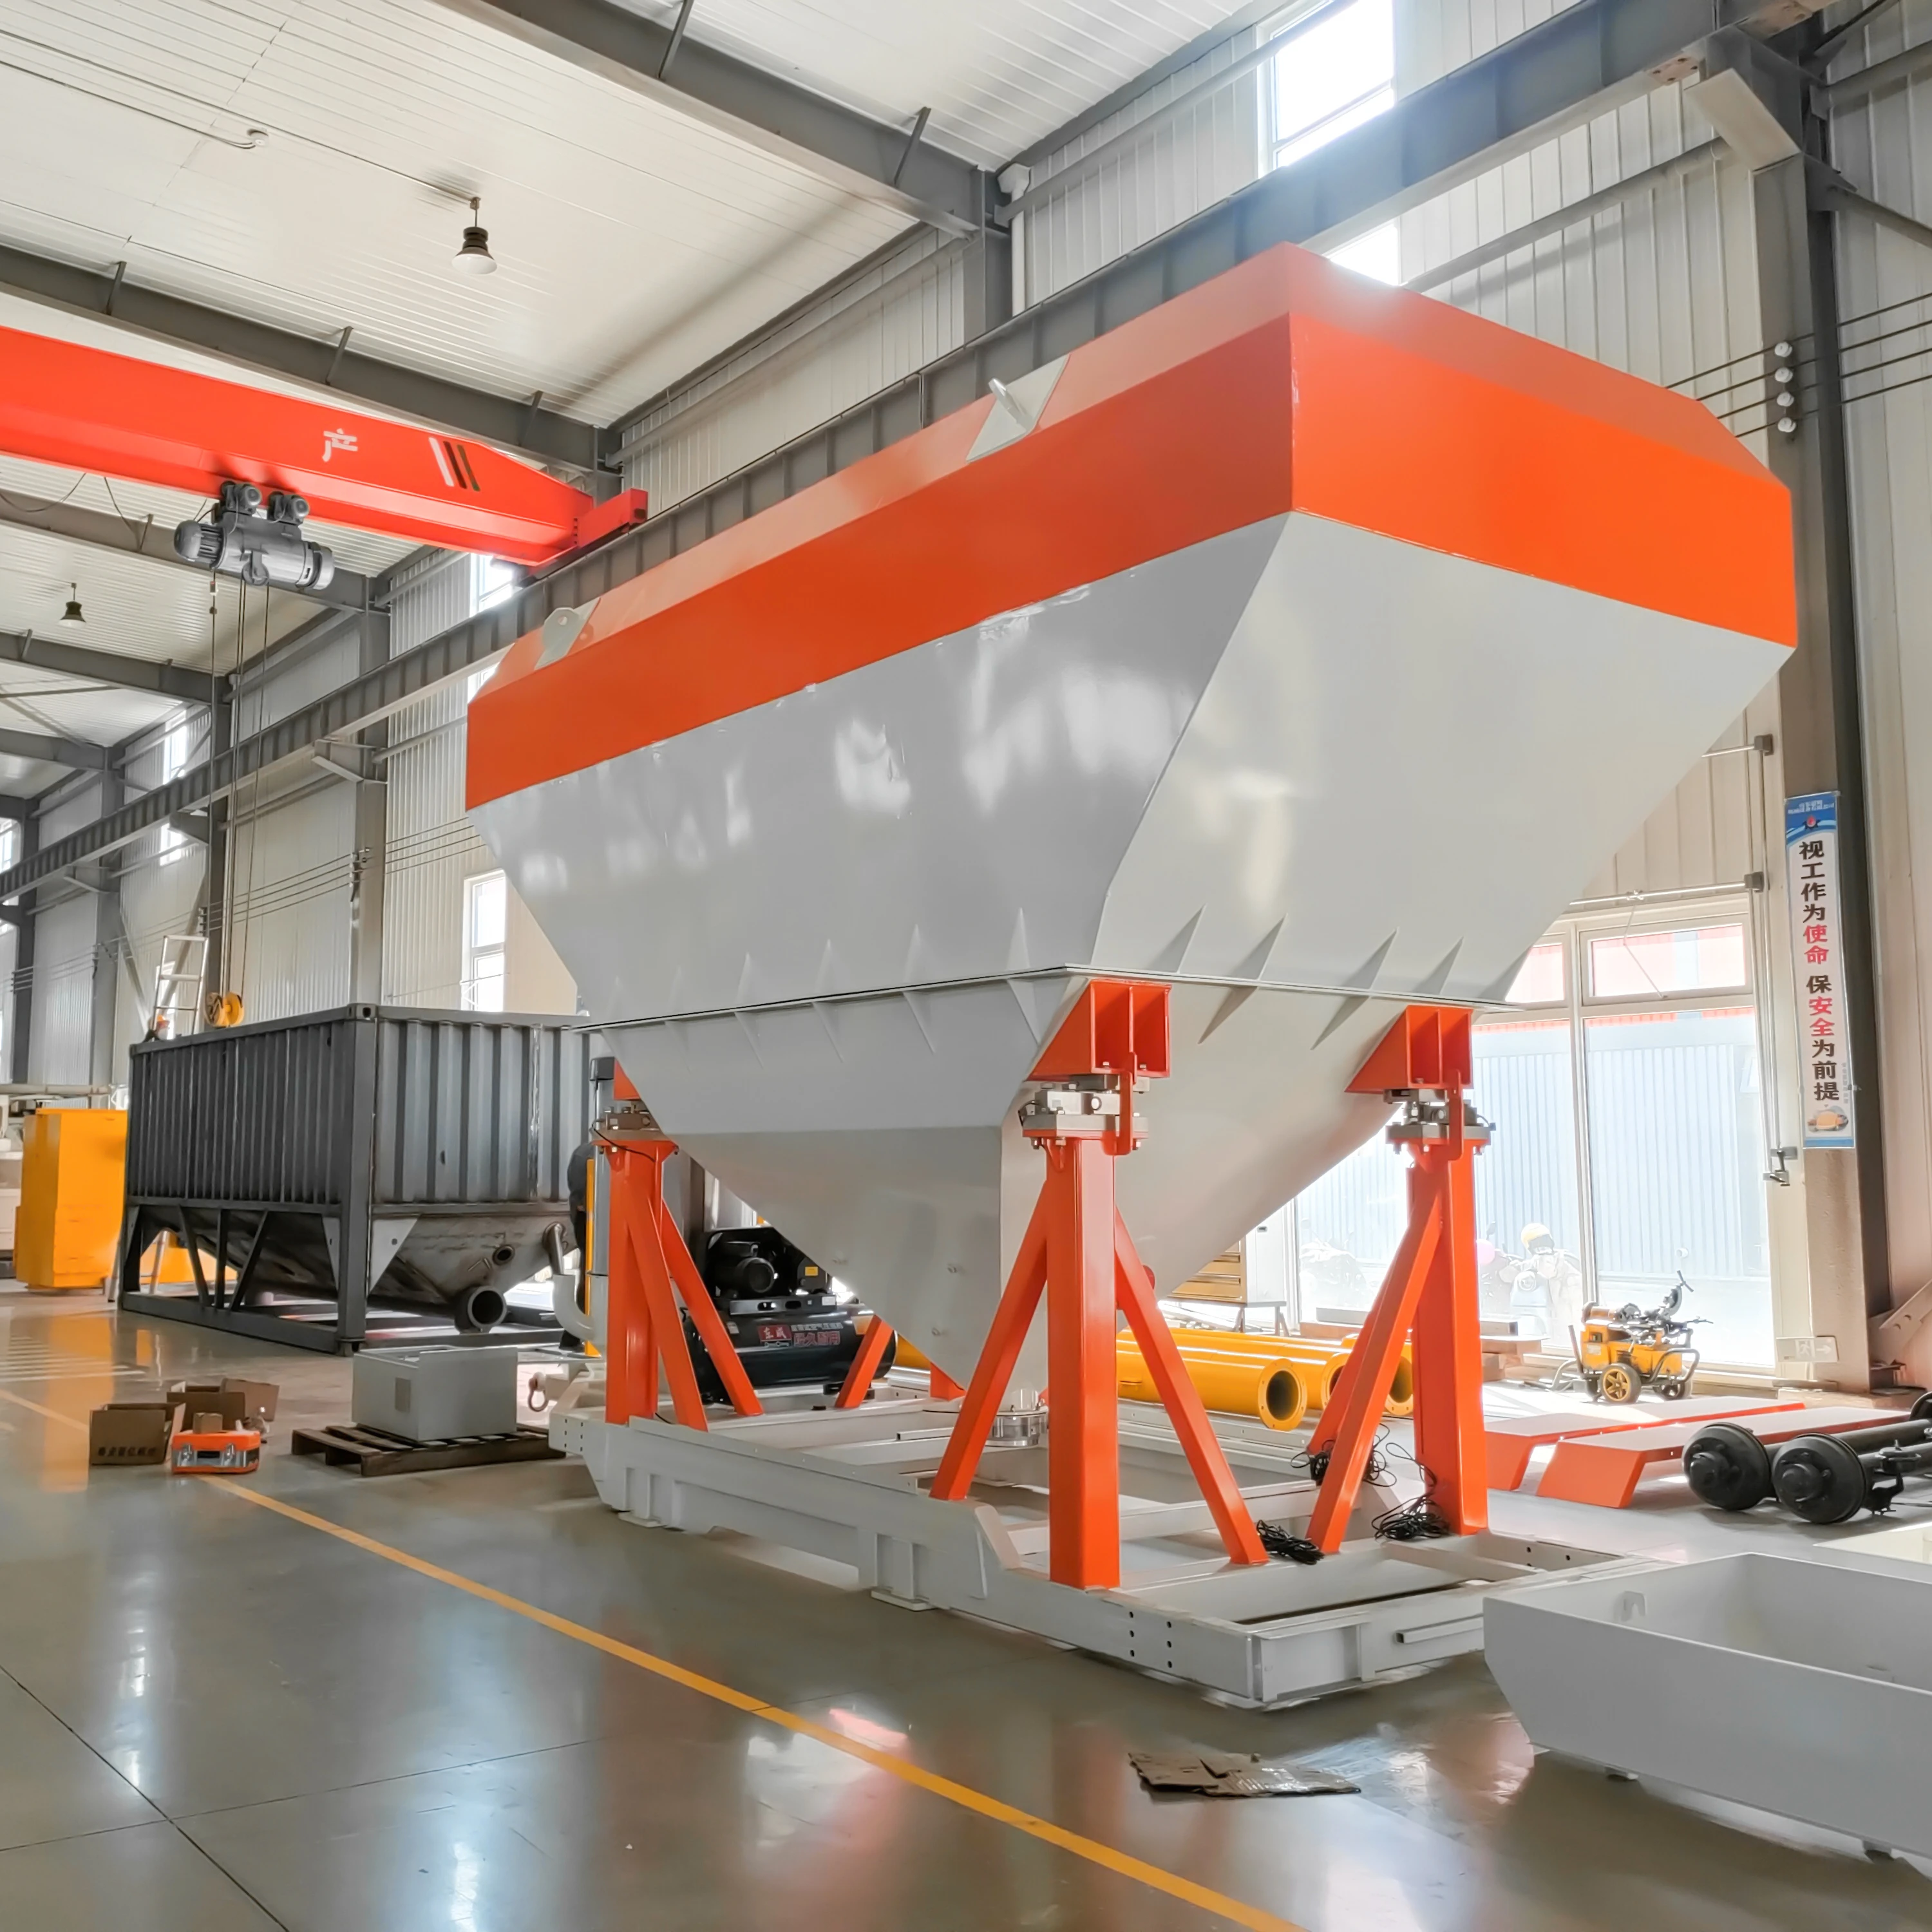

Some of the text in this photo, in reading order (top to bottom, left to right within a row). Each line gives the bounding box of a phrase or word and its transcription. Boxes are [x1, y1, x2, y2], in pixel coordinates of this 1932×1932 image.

[322, 428, 358, 462] 产
[1799, 840, 1830, 965] 视工作为使命
[1806, 974, 1840, 1101] 保安全为前提
